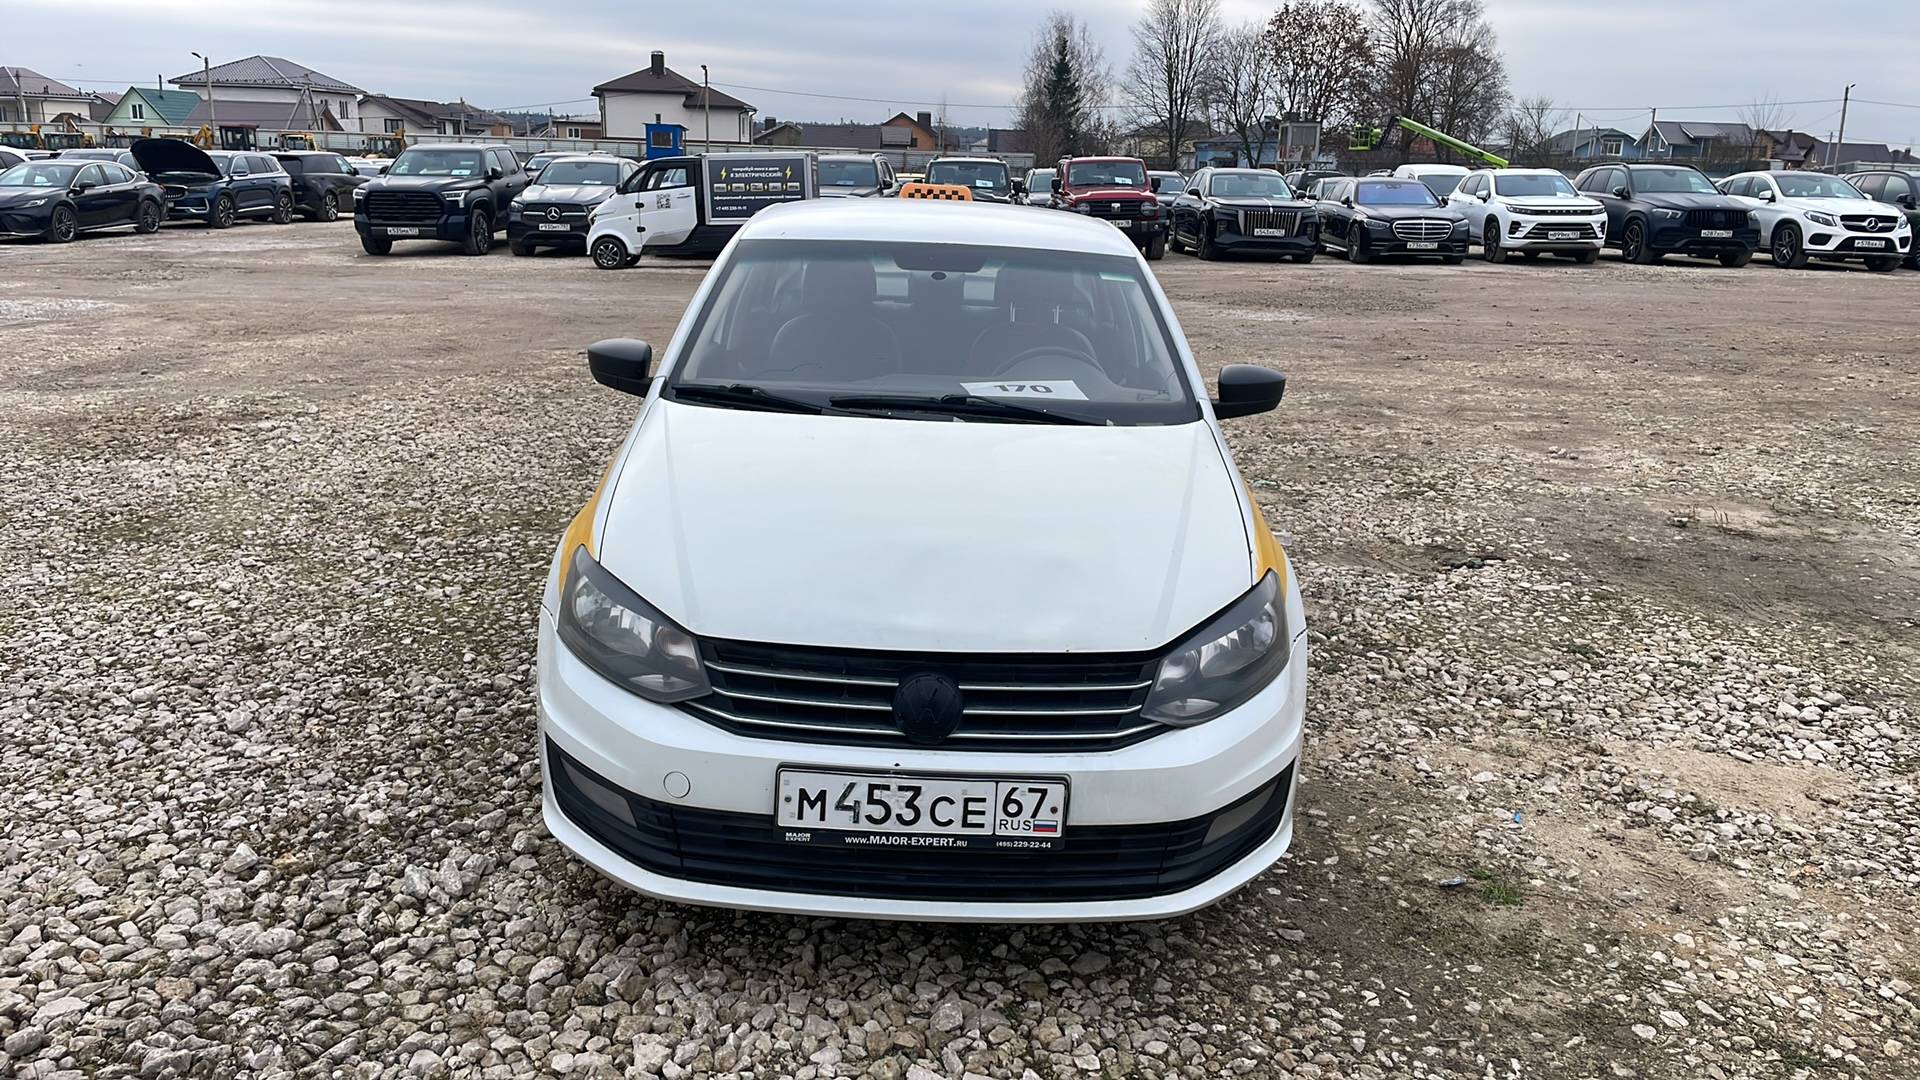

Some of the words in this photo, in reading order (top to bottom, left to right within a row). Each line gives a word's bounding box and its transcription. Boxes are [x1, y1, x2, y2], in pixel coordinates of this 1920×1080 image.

[993, 384, 1054, 394] 170
[1001, 786, 1049, 819] 67
[999, 818, 1032, 832] RUS
